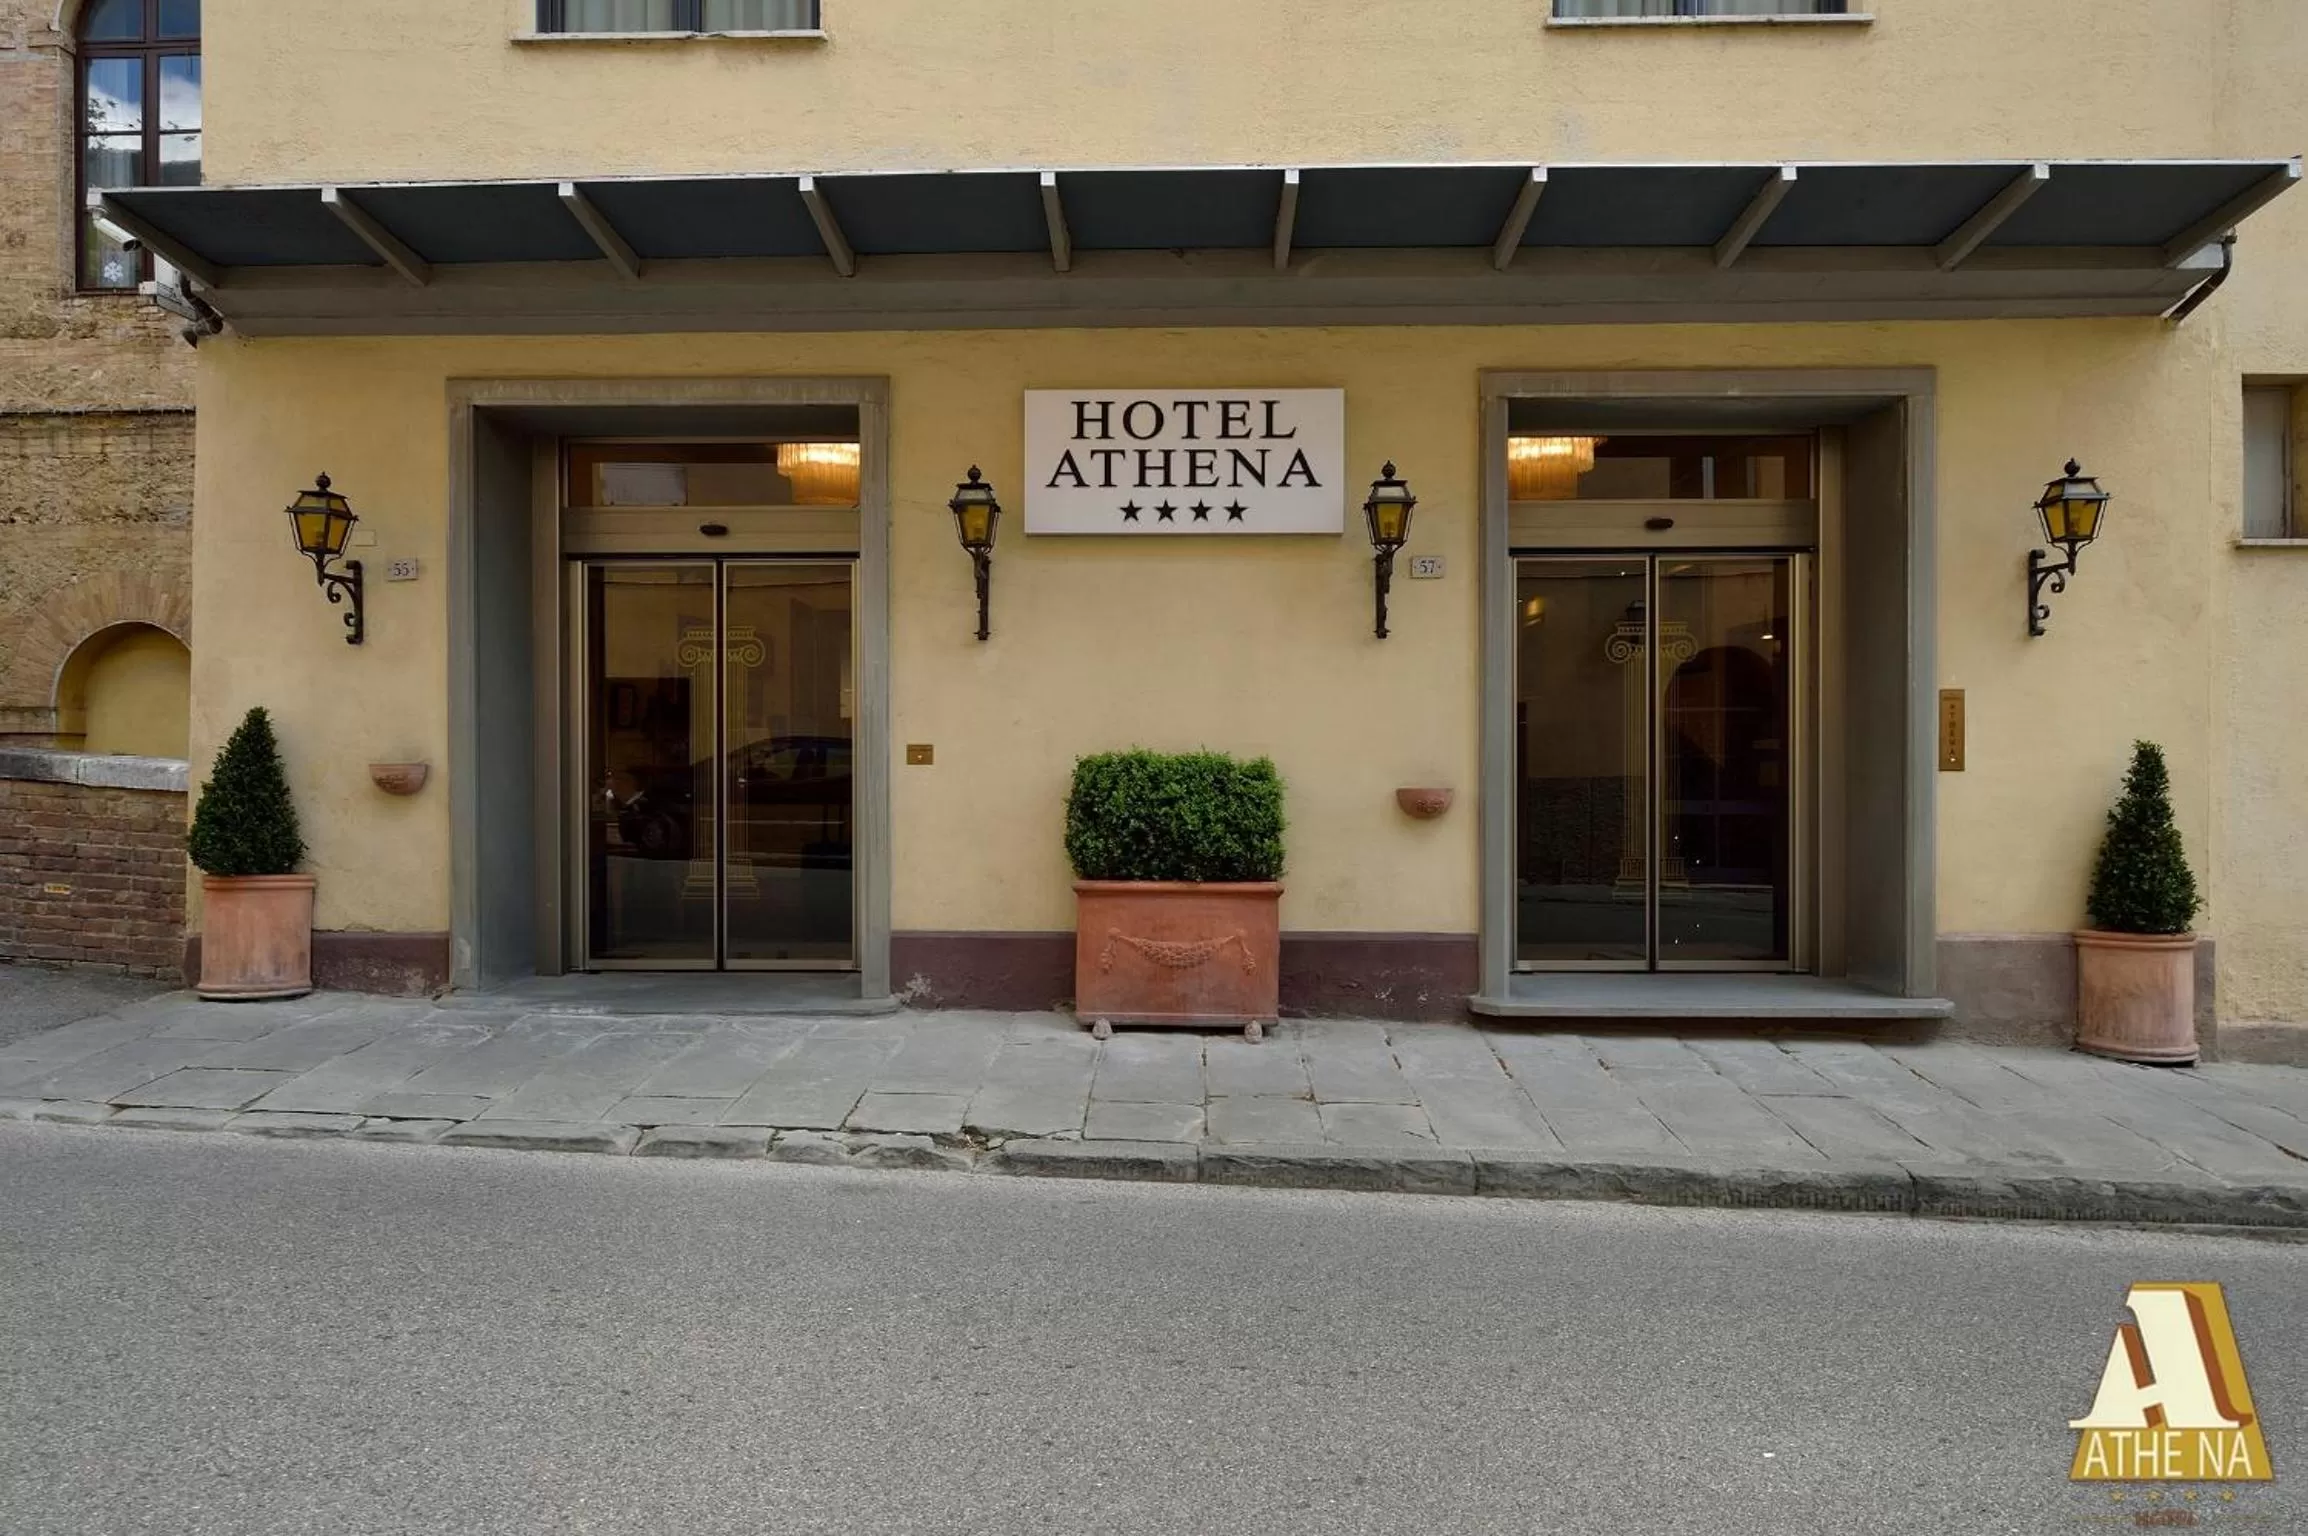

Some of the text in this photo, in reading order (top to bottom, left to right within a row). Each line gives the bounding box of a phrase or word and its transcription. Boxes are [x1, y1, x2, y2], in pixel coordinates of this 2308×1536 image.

[1070, 400, 1297, 440] HOTEL
[1045, 447, 1322, 488] ATHENA
[393, 562, 410, 577] 55
[1420, 560, 1435, 574] 57
